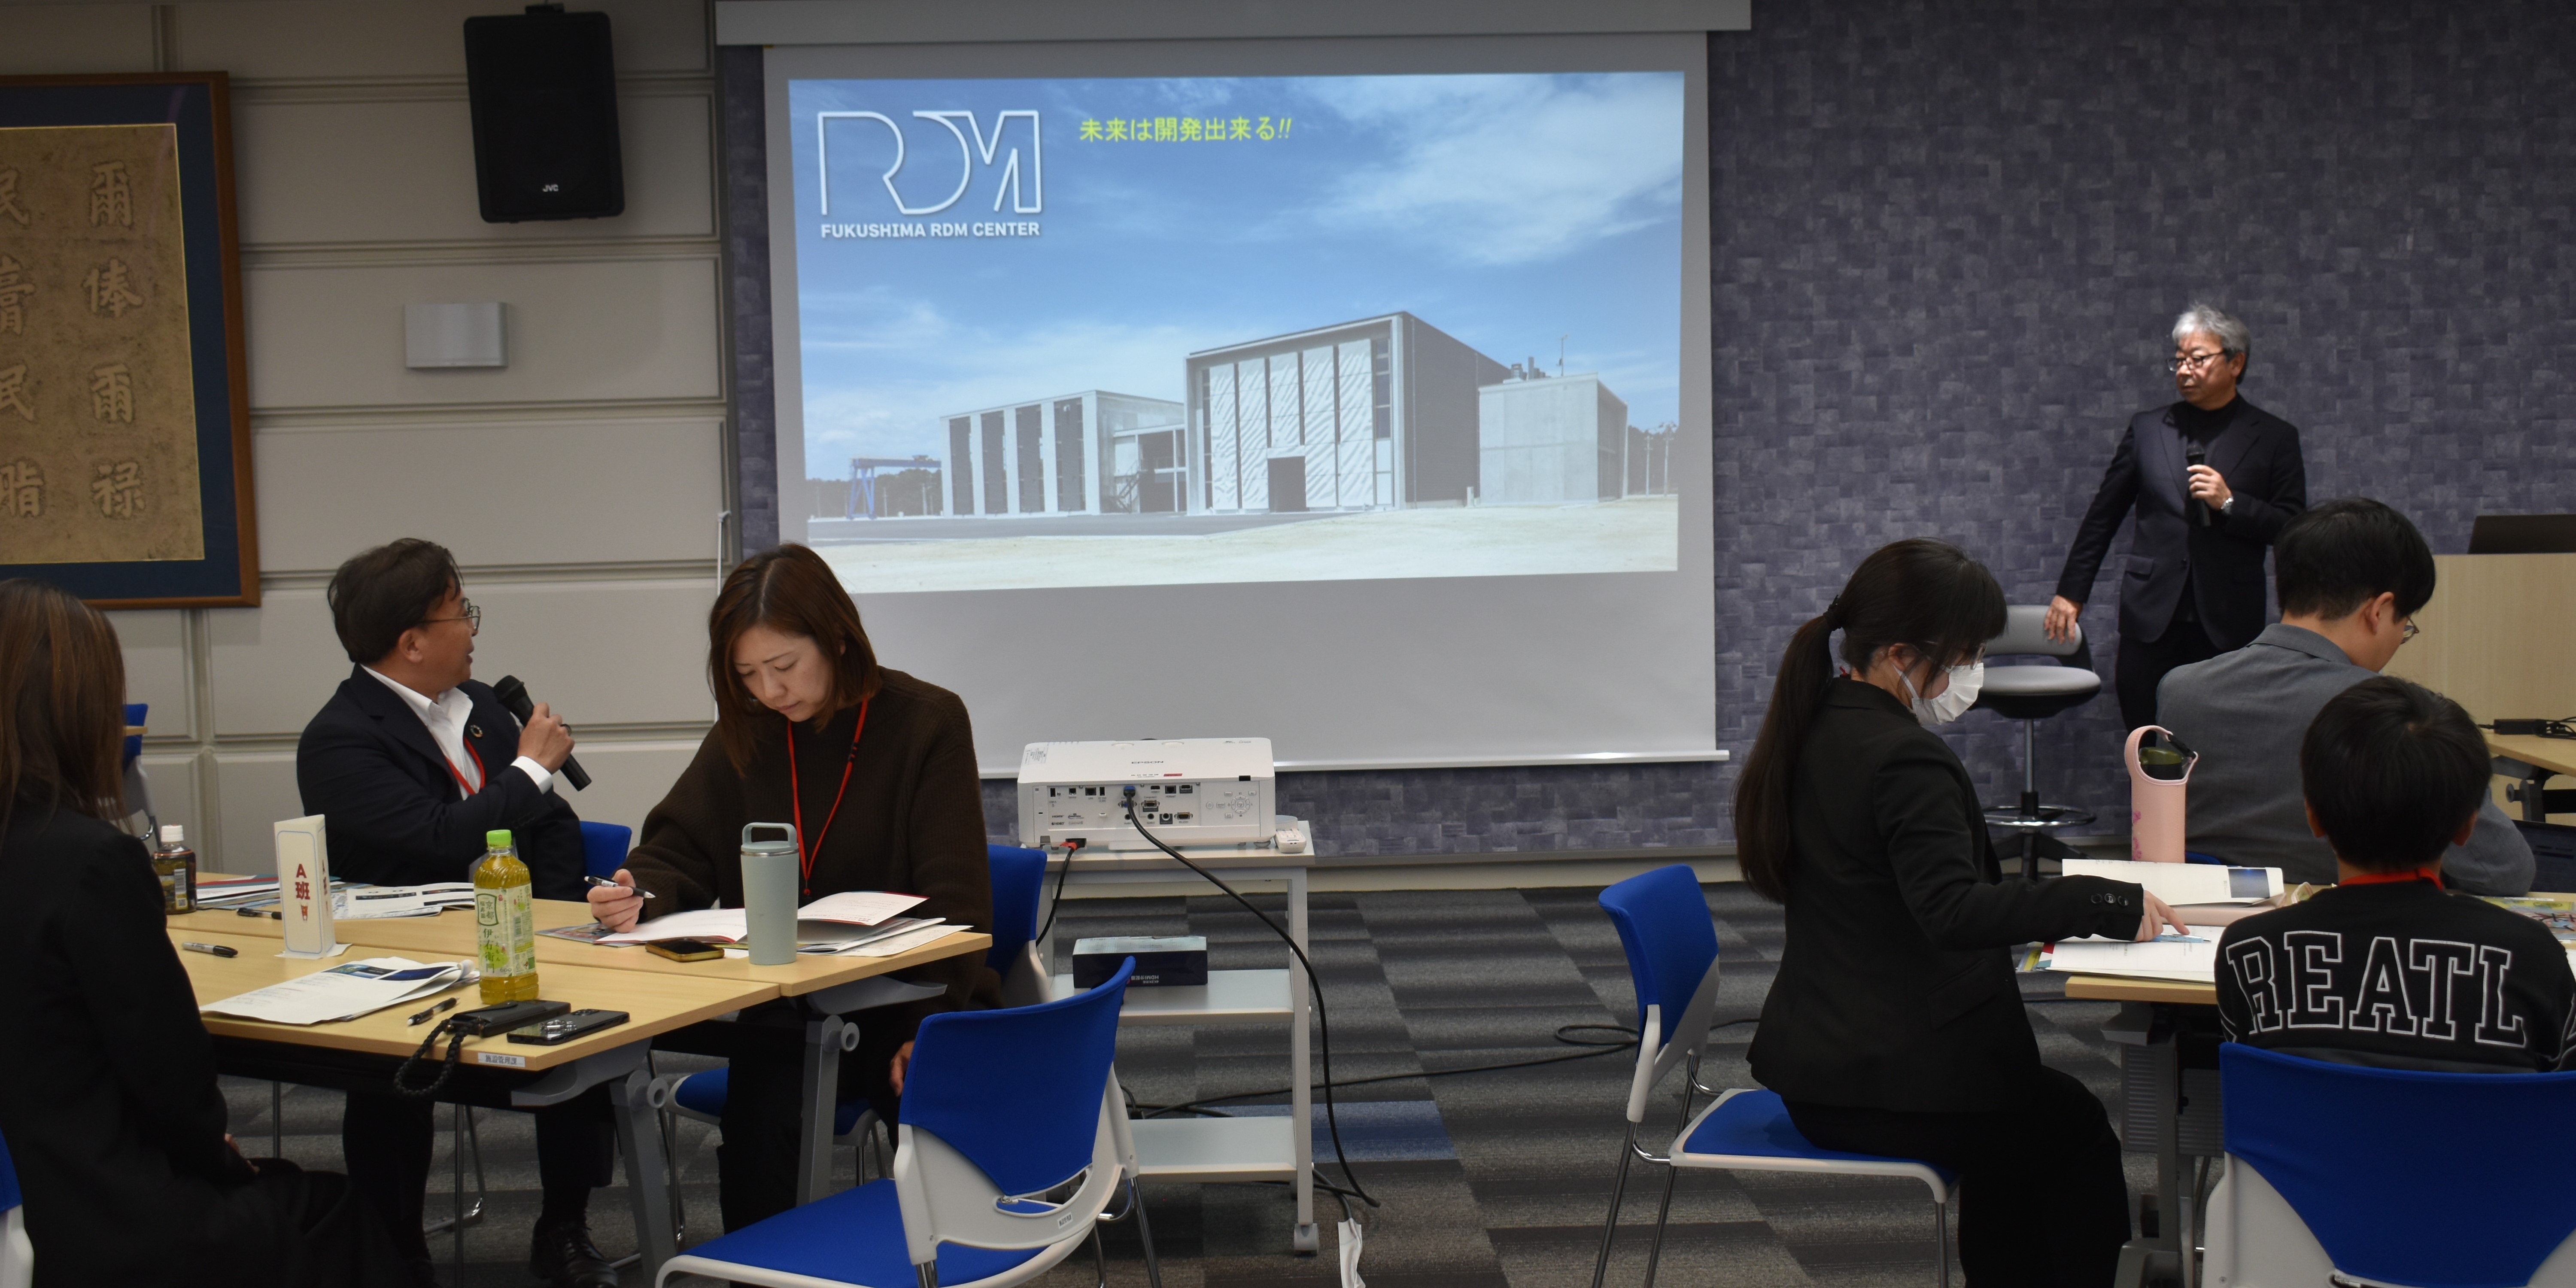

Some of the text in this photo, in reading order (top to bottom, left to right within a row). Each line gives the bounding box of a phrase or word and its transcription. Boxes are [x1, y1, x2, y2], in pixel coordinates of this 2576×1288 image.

[1080, 116, 1292, 142] 未来は開発出来る!!
[818, 110, 1042, 216] RDM
[821, 222, 1040, 238] FUKUSHIMA RDM CENTER
[295, 864, 310, 900] A班
[486, 901, 494, 920] 京都
[483, 928, 495, 973] 伊右衛門
